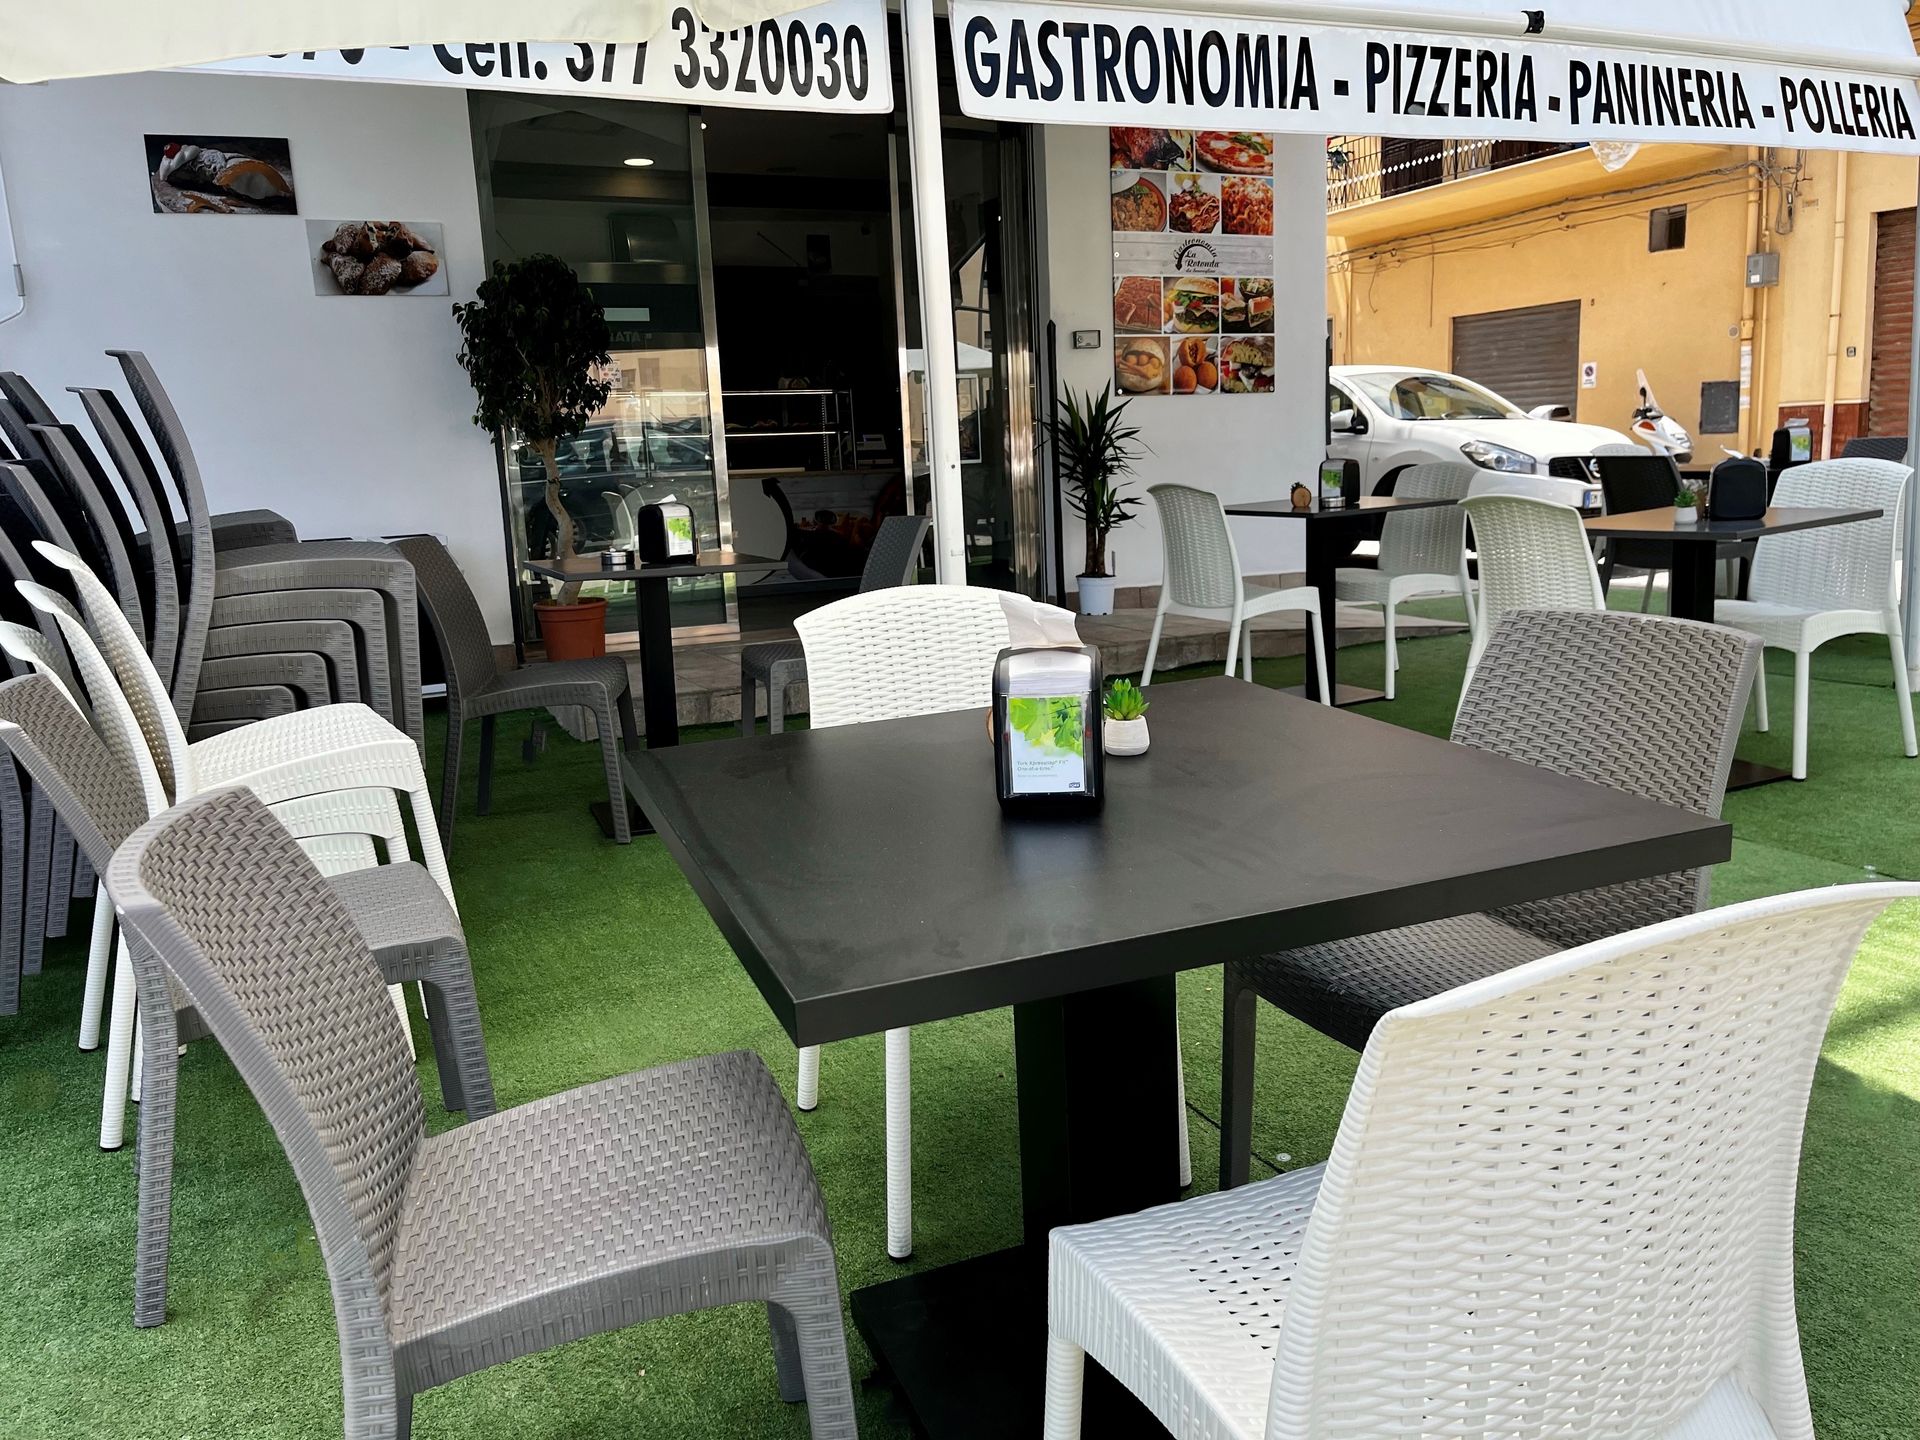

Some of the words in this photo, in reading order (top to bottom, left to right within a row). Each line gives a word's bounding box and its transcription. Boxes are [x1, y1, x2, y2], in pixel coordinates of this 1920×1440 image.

[671, 7, 869, 102] 3320030
[964, 15, 1320, 111] GASTRONOMIA
[1366, 41, 1537, 123] PIZZERIA
[1569, 59, 1756, 129] PANINERIA
[1779, 76, 1917, 140] POLLERIA
[1173, 238, 1218, 260] Gastronomia
[1185, 250, 1196, 258] La
[1185, 259, 1220, 268] Rotonda
